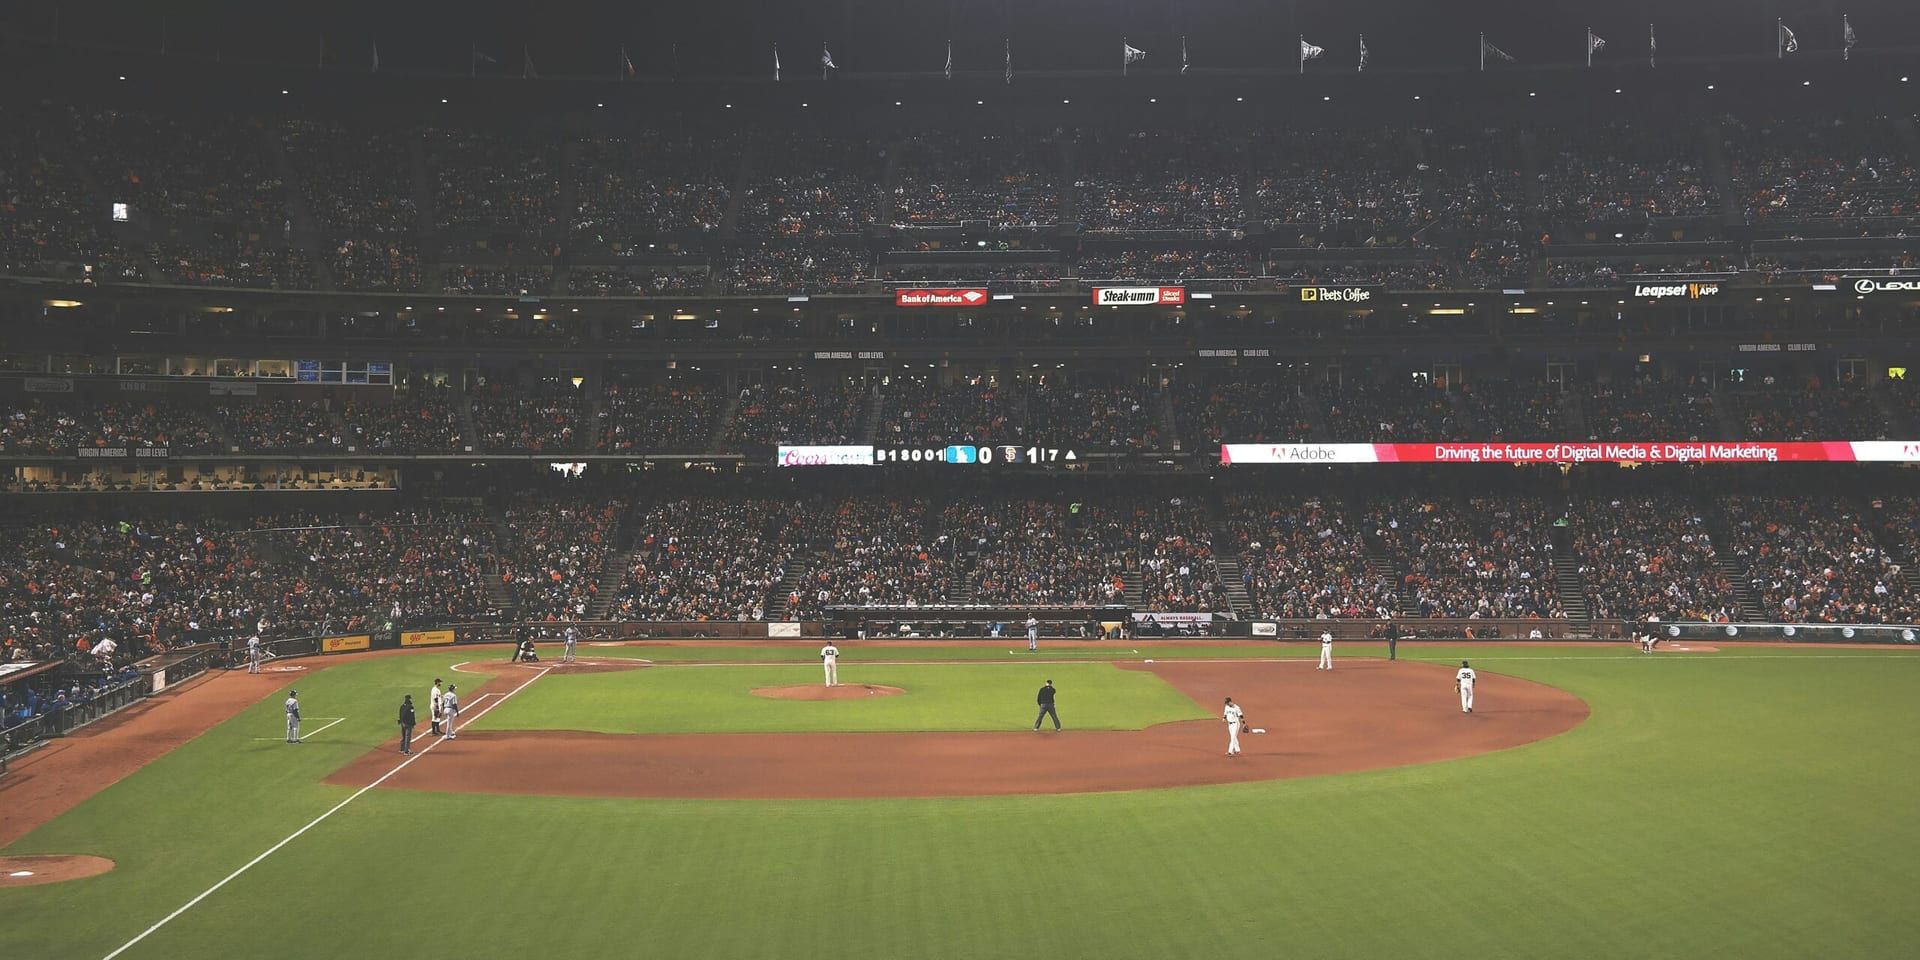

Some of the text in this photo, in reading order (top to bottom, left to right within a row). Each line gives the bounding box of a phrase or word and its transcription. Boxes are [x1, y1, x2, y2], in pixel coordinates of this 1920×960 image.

[1103, 290, 1155, 301] Steak-umm
[1343, 288, 1370, 302] Coffee
[1635, 284, 1687, 298] Leapset
[902, 295, 962, 303] Bank of America
[78, 448, 168, 457] VIRGIN AMERICA CLUB LEVEL
[979, 447, 992, 464] 0
[1026, 447, 1058, 463] 1 7
[1290, 446, 1335, 460] Adobe
[1435, 445, 1777, 462] Driving the future of Digital Media & Digital Marketing
